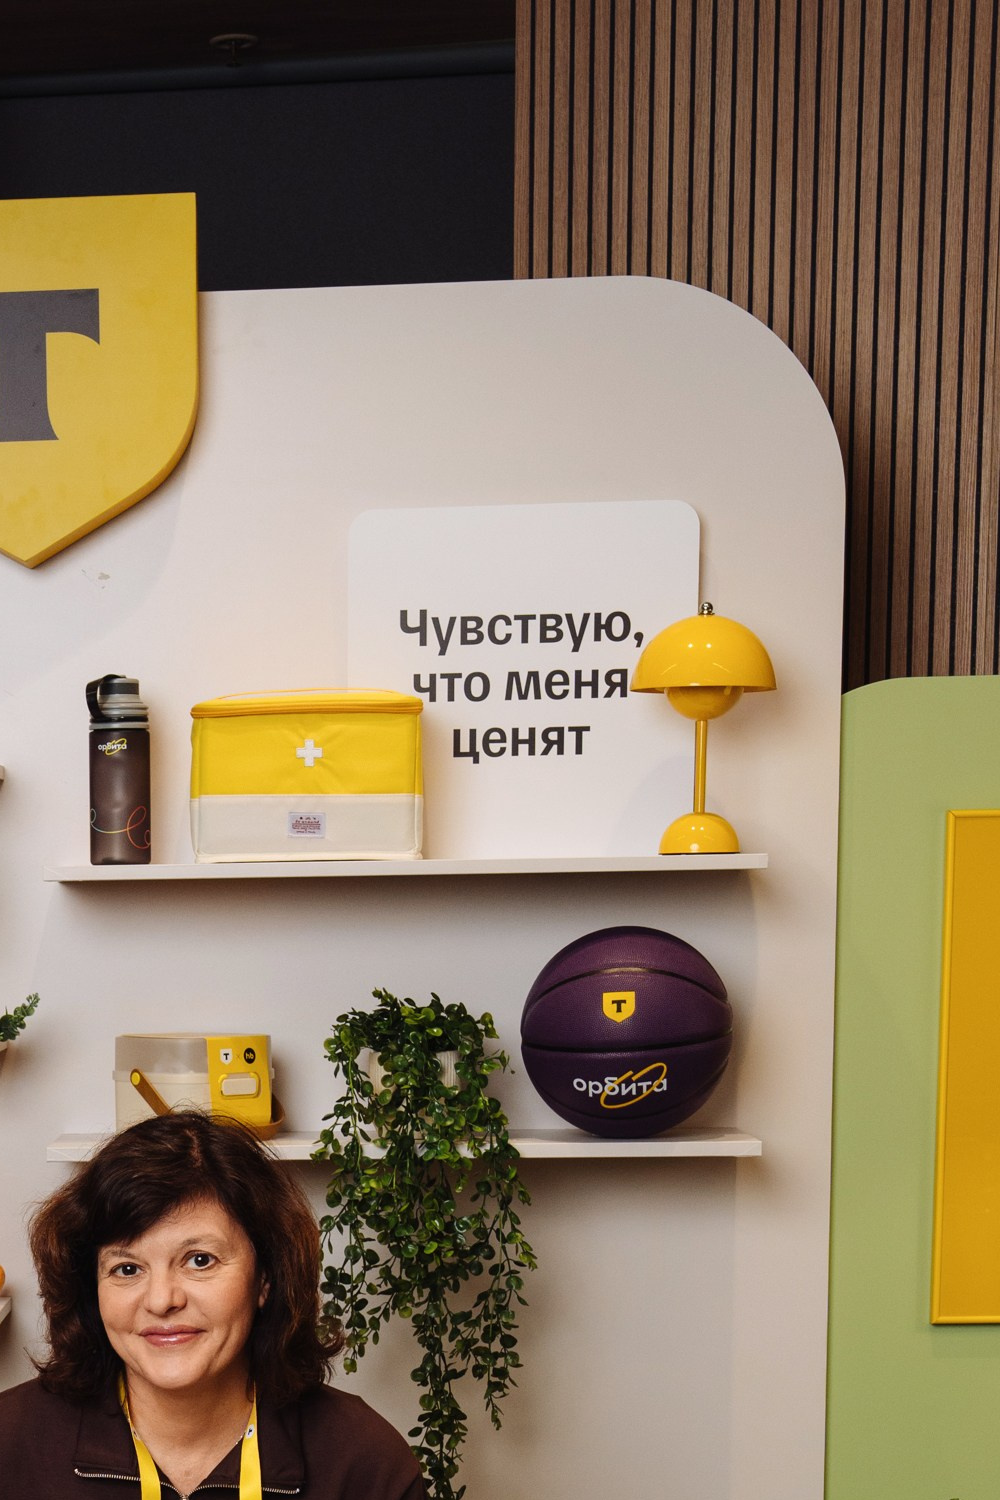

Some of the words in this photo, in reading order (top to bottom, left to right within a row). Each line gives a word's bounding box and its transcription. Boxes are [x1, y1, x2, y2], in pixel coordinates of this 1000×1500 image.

[399, 610, 644, 656] Чувствую,
[413, 672, 490, 704] что
[505, 668, 630, 702] меня
[453, 726, 591, 765] ценят
[612, 1000, 627, 1013] Т
